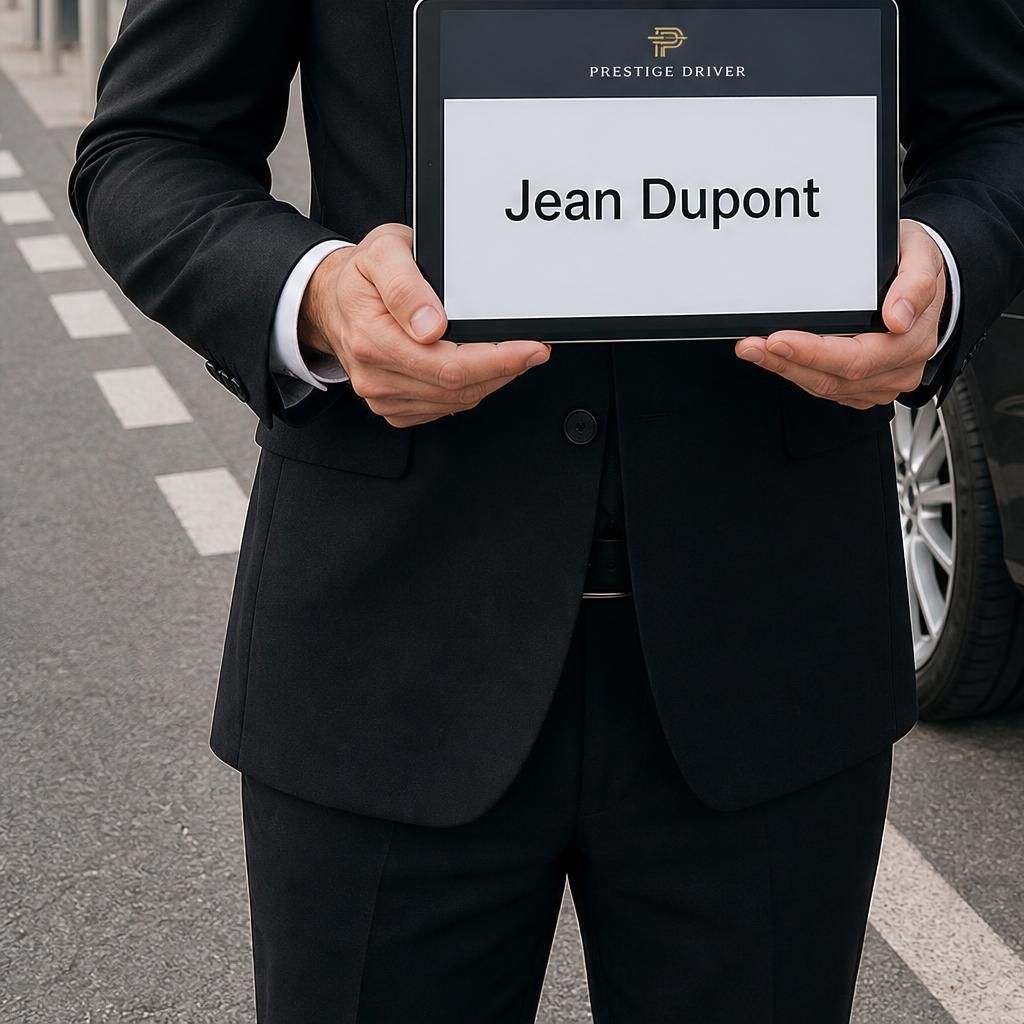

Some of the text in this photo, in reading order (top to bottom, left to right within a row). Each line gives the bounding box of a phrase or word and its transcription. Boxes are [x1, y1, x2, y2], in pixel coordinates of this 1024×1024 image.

[589, 65, 746, 78] PRESTIGE DRIVER
[504, 177, 821, 230] Jean Dupont
